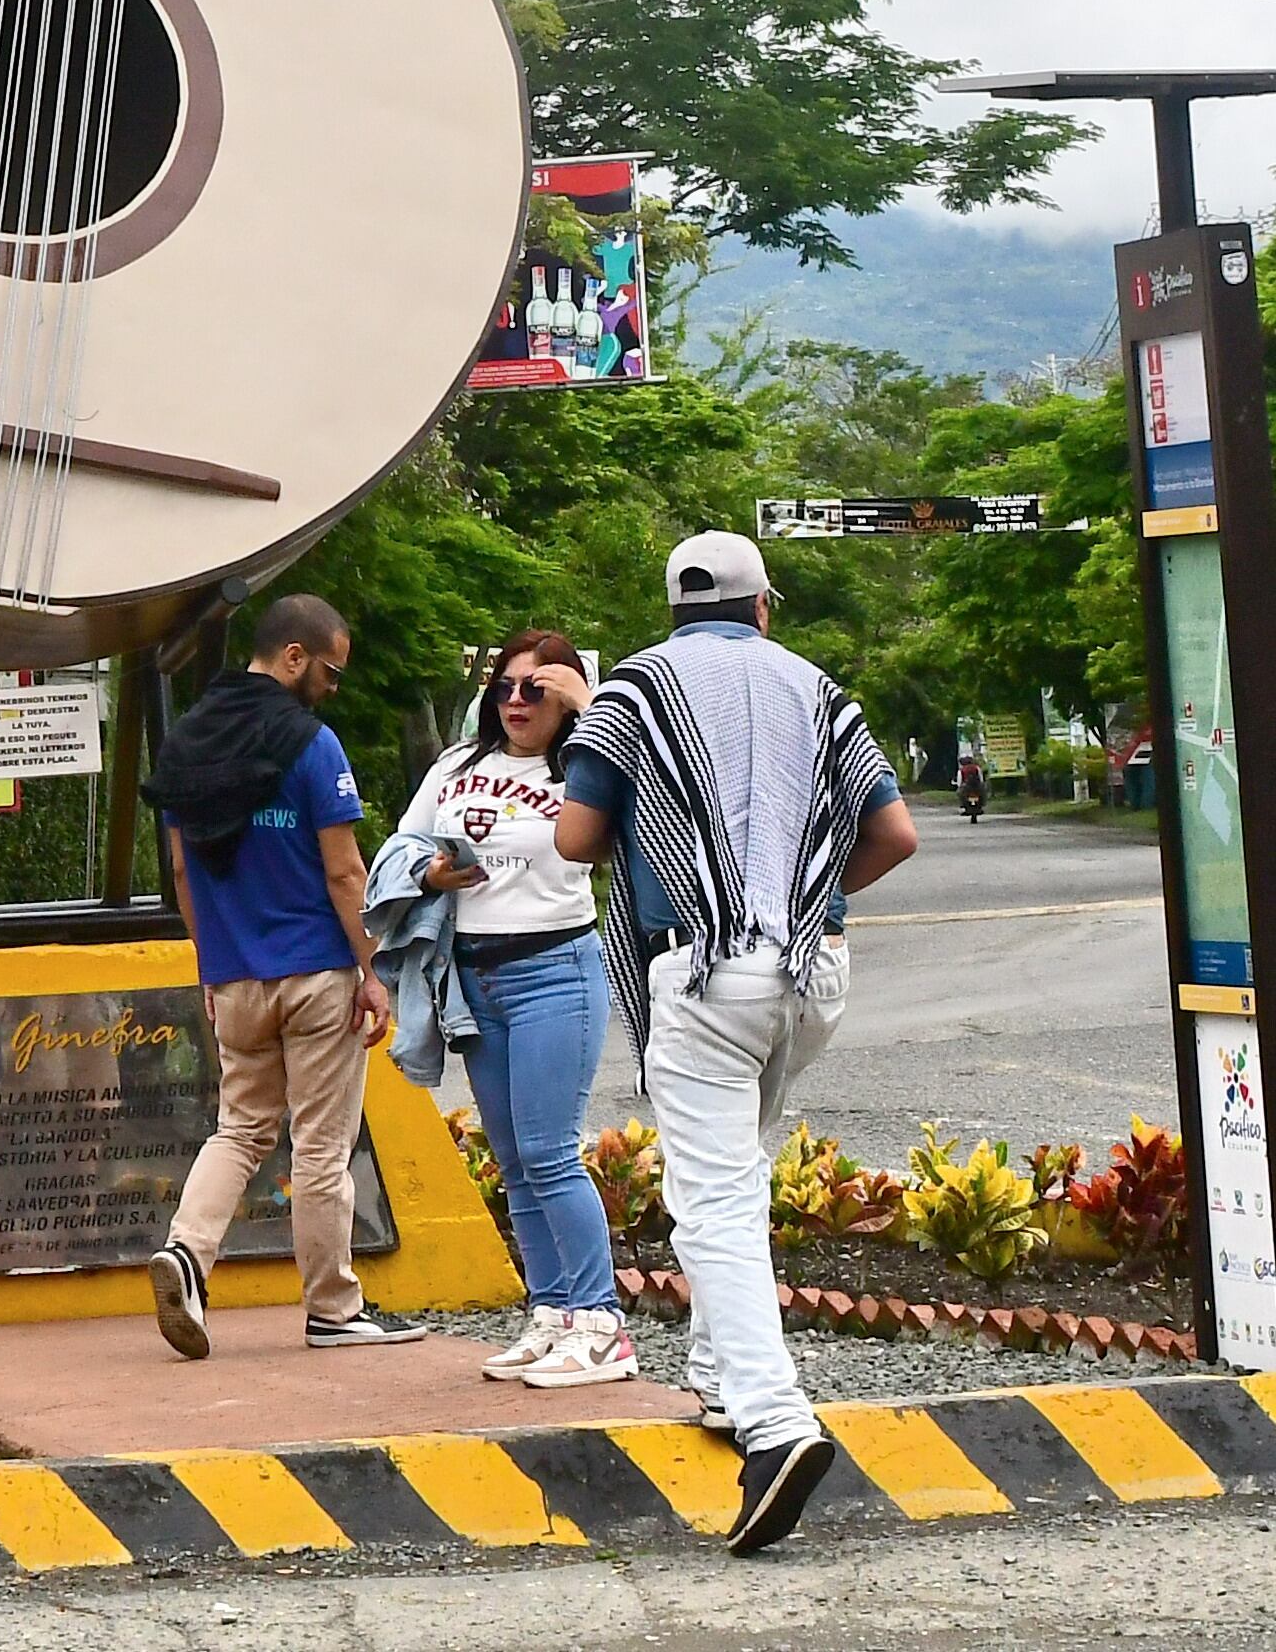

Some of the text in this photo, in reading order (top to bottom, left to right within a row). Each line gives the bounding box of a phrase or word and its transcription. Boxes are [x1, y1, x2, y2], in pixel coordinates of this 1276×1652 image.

[47, 693, 89, 702] TENEMOS
[27, 706, 80, 716] DEMUESTRA
[12, 722, 23, 730] LA
[8, 735, 25, 743] ESO
[42, 732, 77, 740] PEGUES
[40, 743, 86, 752] LETREROS
[22, 757, 45, 766] ESTA
[253, 809, 297, 828] NEWS
[476, 854, 534, 870] ERSITY
[10, 1007, 179, 1074] Ginebra
[8, 1091, 25, 1104] LA
[100, 1083, 161, 1101] ANINA
[56, 1110, 67, 1124] A
[72, 1107, 95, 1122] SU
[63, 1148, 74, 1163] Y
[78, 1147, 98, 1162] LA
[102, 1143, 174, 1161] CULTURA
[128, 1210, 161, 1226] S.A.
